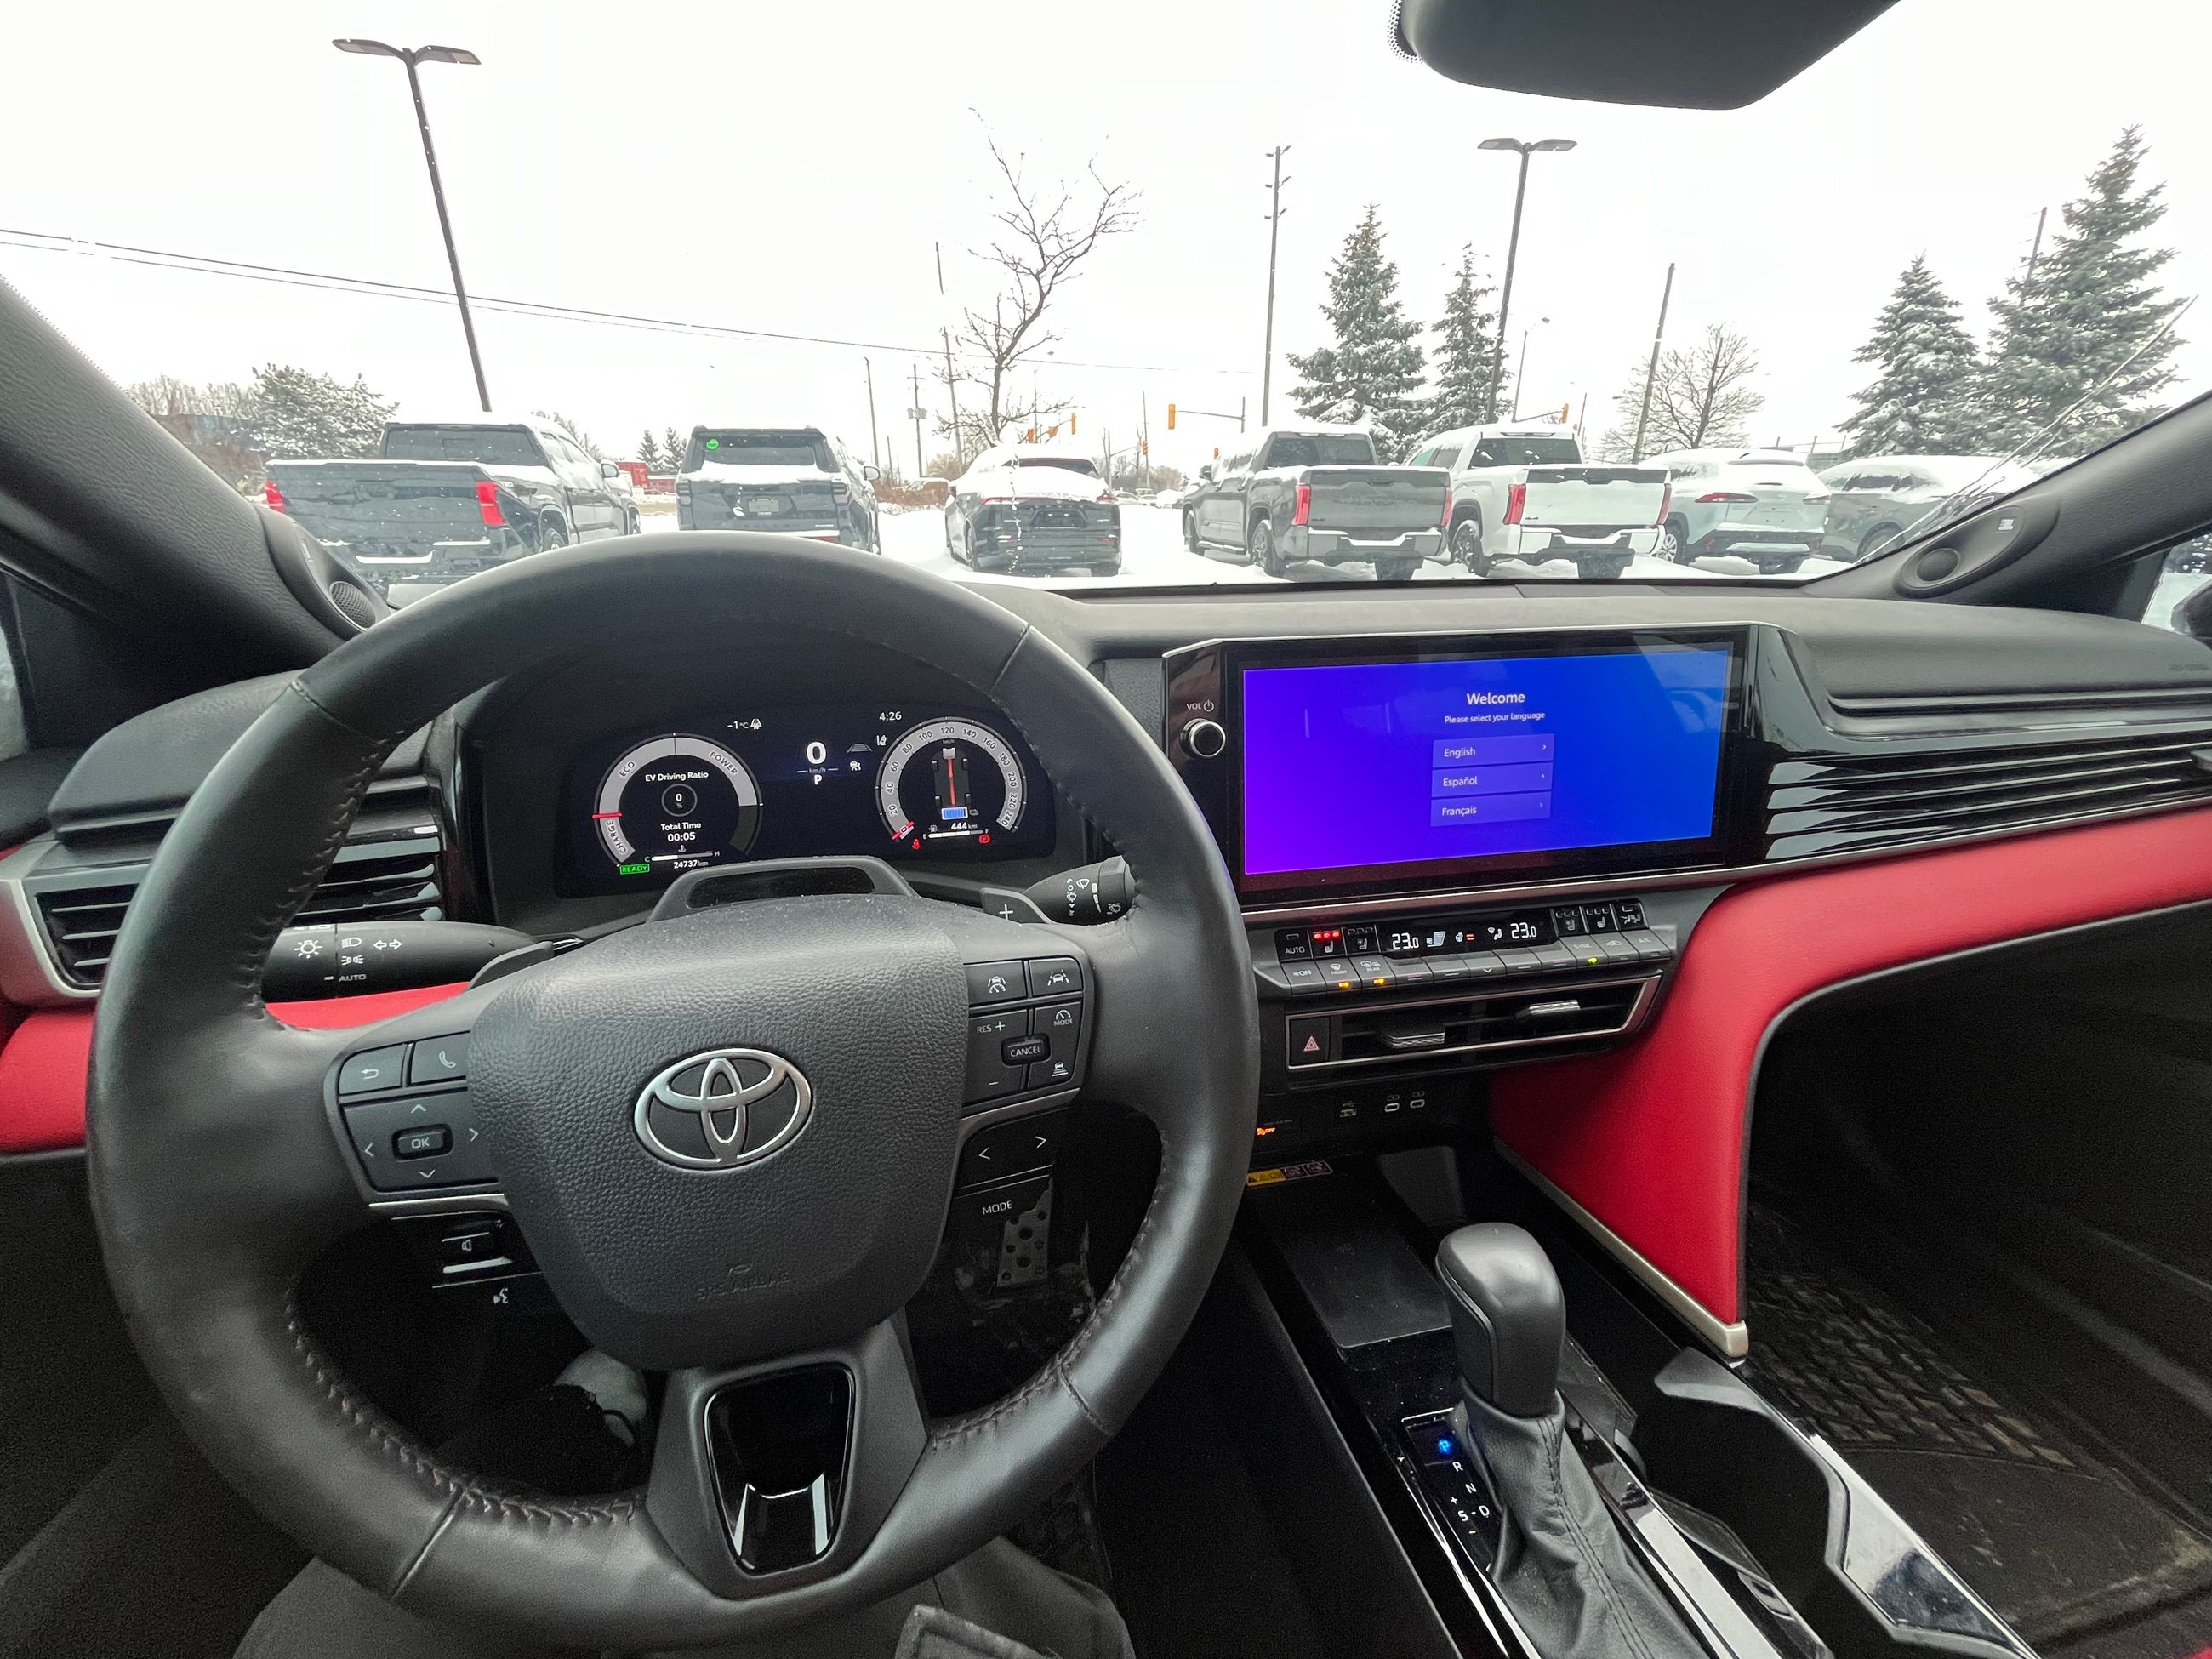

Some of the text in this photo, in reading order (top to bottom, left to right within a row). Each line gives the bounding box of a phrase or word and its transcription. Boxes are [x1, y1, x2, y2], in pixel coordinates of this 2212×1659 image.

[1466, 692, 1525, 705] Welcome
[879, 711, 902, 721] 4:26
[1470, 714, 1491, 722] select
[1492, 714, 1509, 722] your
[1510, 712, 1546, 721] language
[918, 731, 933, 742] 100
[962, 728, 977, 738] 140
[902, 743, 913, 755] 80
[983, 737, 996, 750] 160
[806, 741, 827, 765] 0
[1444, 747, 1476, 759] English
[710, 751, 738, 775] POWER
[998, 752, 1011, 767] 180
[619, 761, 635, 778] ECO
[891, 761, 899, 772] 60
[658, 772, 686, 782] Driving
[687, 771, 709, 779] Ratio
[814, 774, 823, 785] P
[1007, 772, 1017, 788] 200
[1443, 776, 1478, 788] Español
[887, 783, 893, 793] 40
[676, 793, 683, 802] 0
[1007, 794, 1018, 808] 220
[889, 805, 898, 817] 20
[1442, 807, 1477, 818] Français
[1001, 811, 1014, 827] 240
[660, 823, 681, 831] Total
[951, 822, 967, 830] 444
[607, 820, 627, 855] CHARGE
[667, 831, 696, 841] 00:05
[673, 860, 698, 869] 24737
[1510, 921, 1537, 939] 23.0
[1392, 932, 1420, 950] 23.0
[1285, 946, 1306, 955] AUTO
[339, 973, 367, 982] AUTO
[977, 1024, 992, 1033] RES
[1010, 1046, 1041, 1057] CANCEL
[411, 1137, 430, 1149] OK
[982, 1200, 1012, 1215] MODE
[1452, 1462, 1463, 1472] R
[1465, 1482, 1477, 1494] N
[1457, 1505, 1490, 1522] S D
